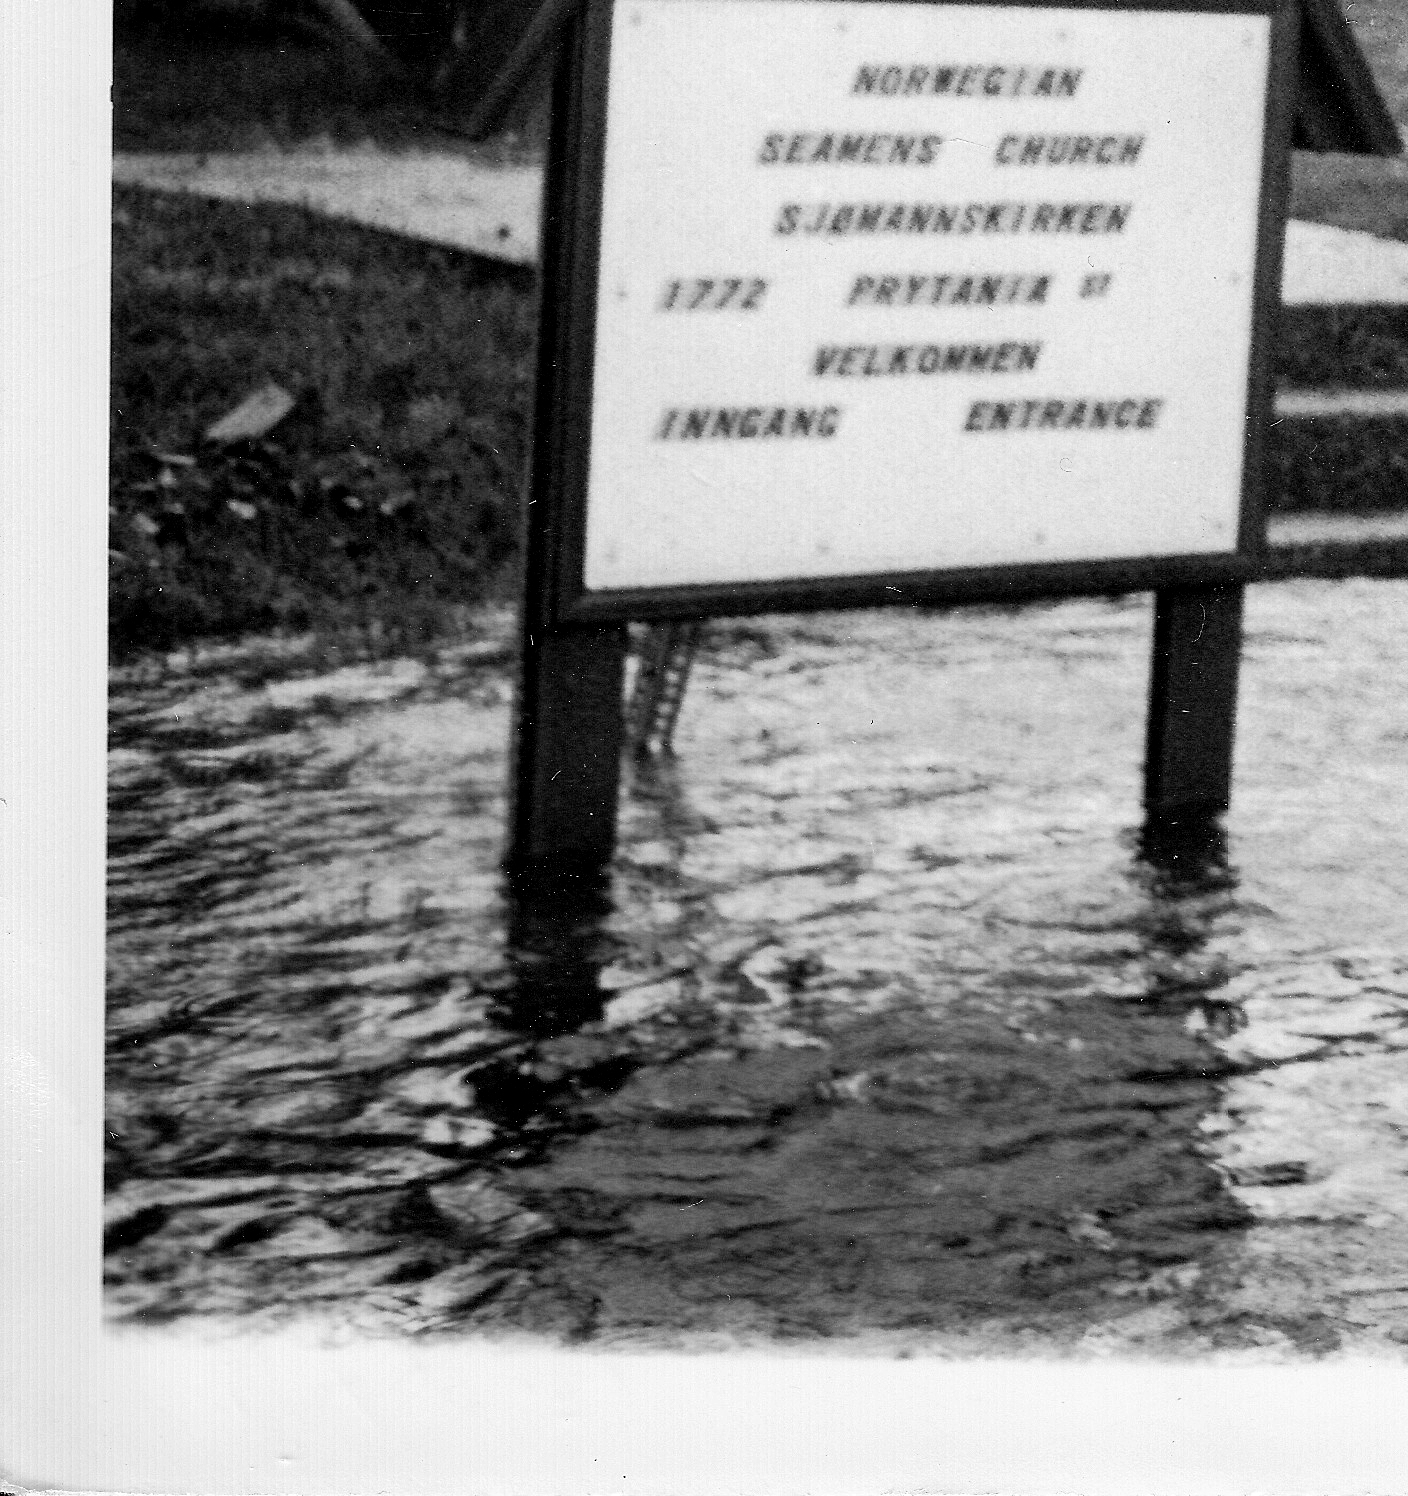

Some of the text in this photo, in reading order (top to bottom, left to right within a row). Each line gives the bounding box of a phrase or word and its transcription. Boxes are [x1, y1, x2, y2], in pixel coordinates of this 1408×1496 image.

[853, 65, 1082, 97] NORWEGIAN
[759, 133, 1144, 165] SEAMENS CHURCH
[775, 203, 1131, 236] SJØMANNSKIRKEN
[661, 278, 767, 311] 1772
[848, 274, 1052, 305] PRYTANIA
[812, 341, 1041, 378] VELKOMMEN
[655, 398, 1163, 441] INNGANG ENTRANCE
